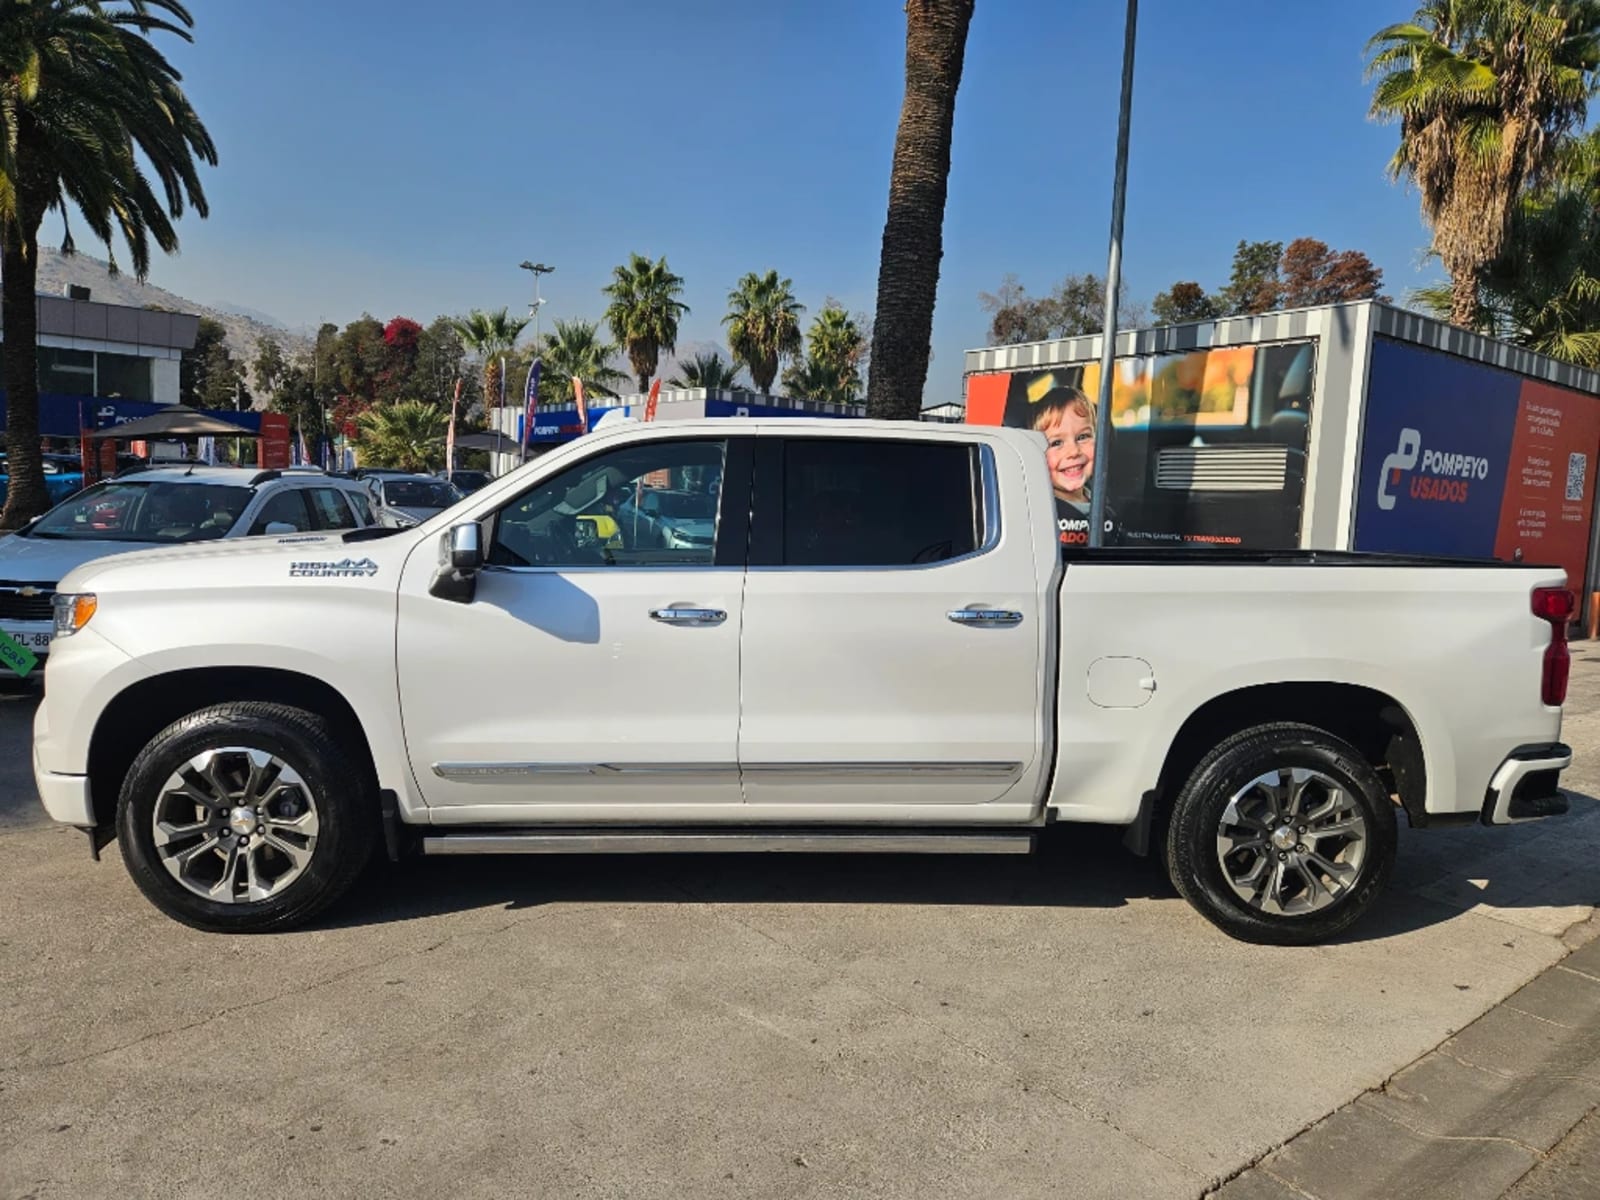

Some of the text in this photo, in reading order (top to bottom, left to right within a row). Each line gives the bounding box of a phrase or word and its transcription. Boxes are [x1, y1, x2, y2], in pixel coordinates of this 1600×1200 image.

[1421, 449, 1489, 481] POMPEYO
[1410, 475, 1469, 503] USADOS
[1057, 518, 1114, 533] OMPO
[289, 561, 335, 570] HIGH
[288, 569, 379, 578] COUNTRY
